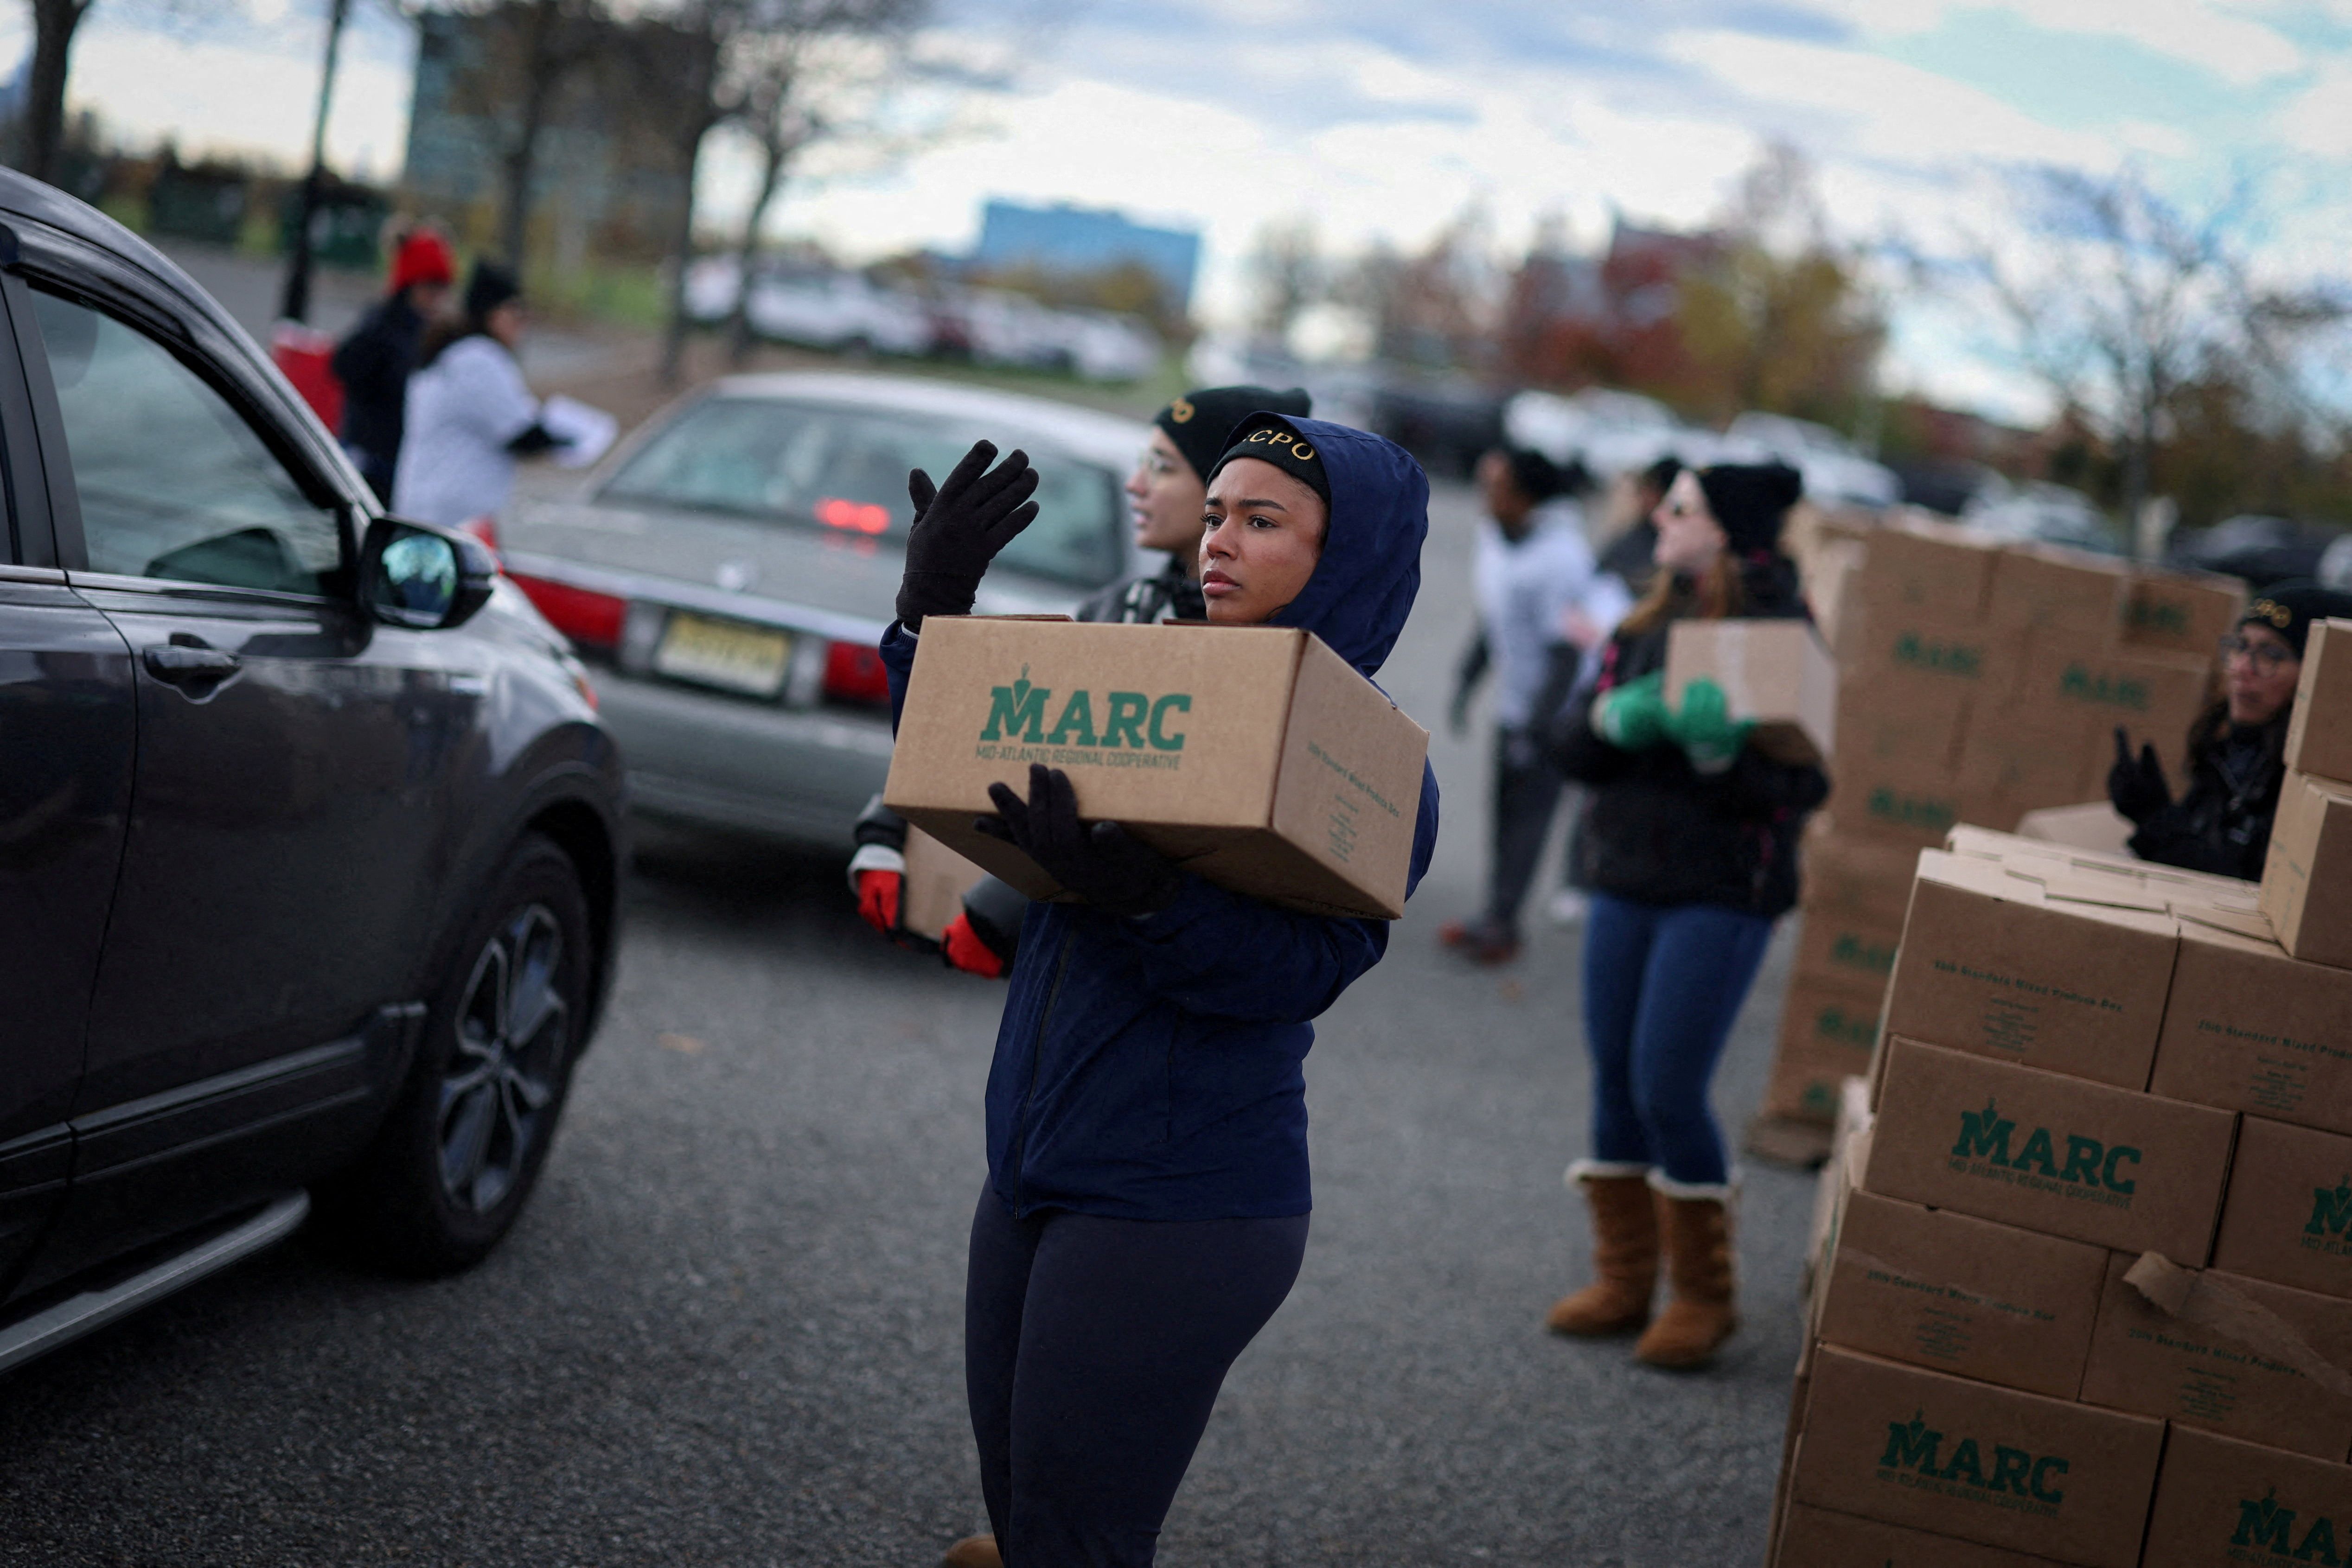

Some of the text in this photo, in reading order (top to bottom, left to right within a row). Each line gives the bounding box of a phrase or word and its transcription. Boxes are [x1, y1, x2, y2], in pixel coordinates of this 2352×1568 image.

[1243, 429, 1316, 460] CPO
[980, 680, 1192, 750] MARC
[976, 746, 1181, 770] MID-ATLANTIC REGIONAL COOPERATIVE
[2101, 997, 2122, 1013] Box
[1951, 1108, 2142, 1195] MARC
[2066, 1184, 2133, 1210] COOPERATIVE
[1879, 1420, 2070, 1504] MARC
[2230, 1498, 2352, 1568] MA
